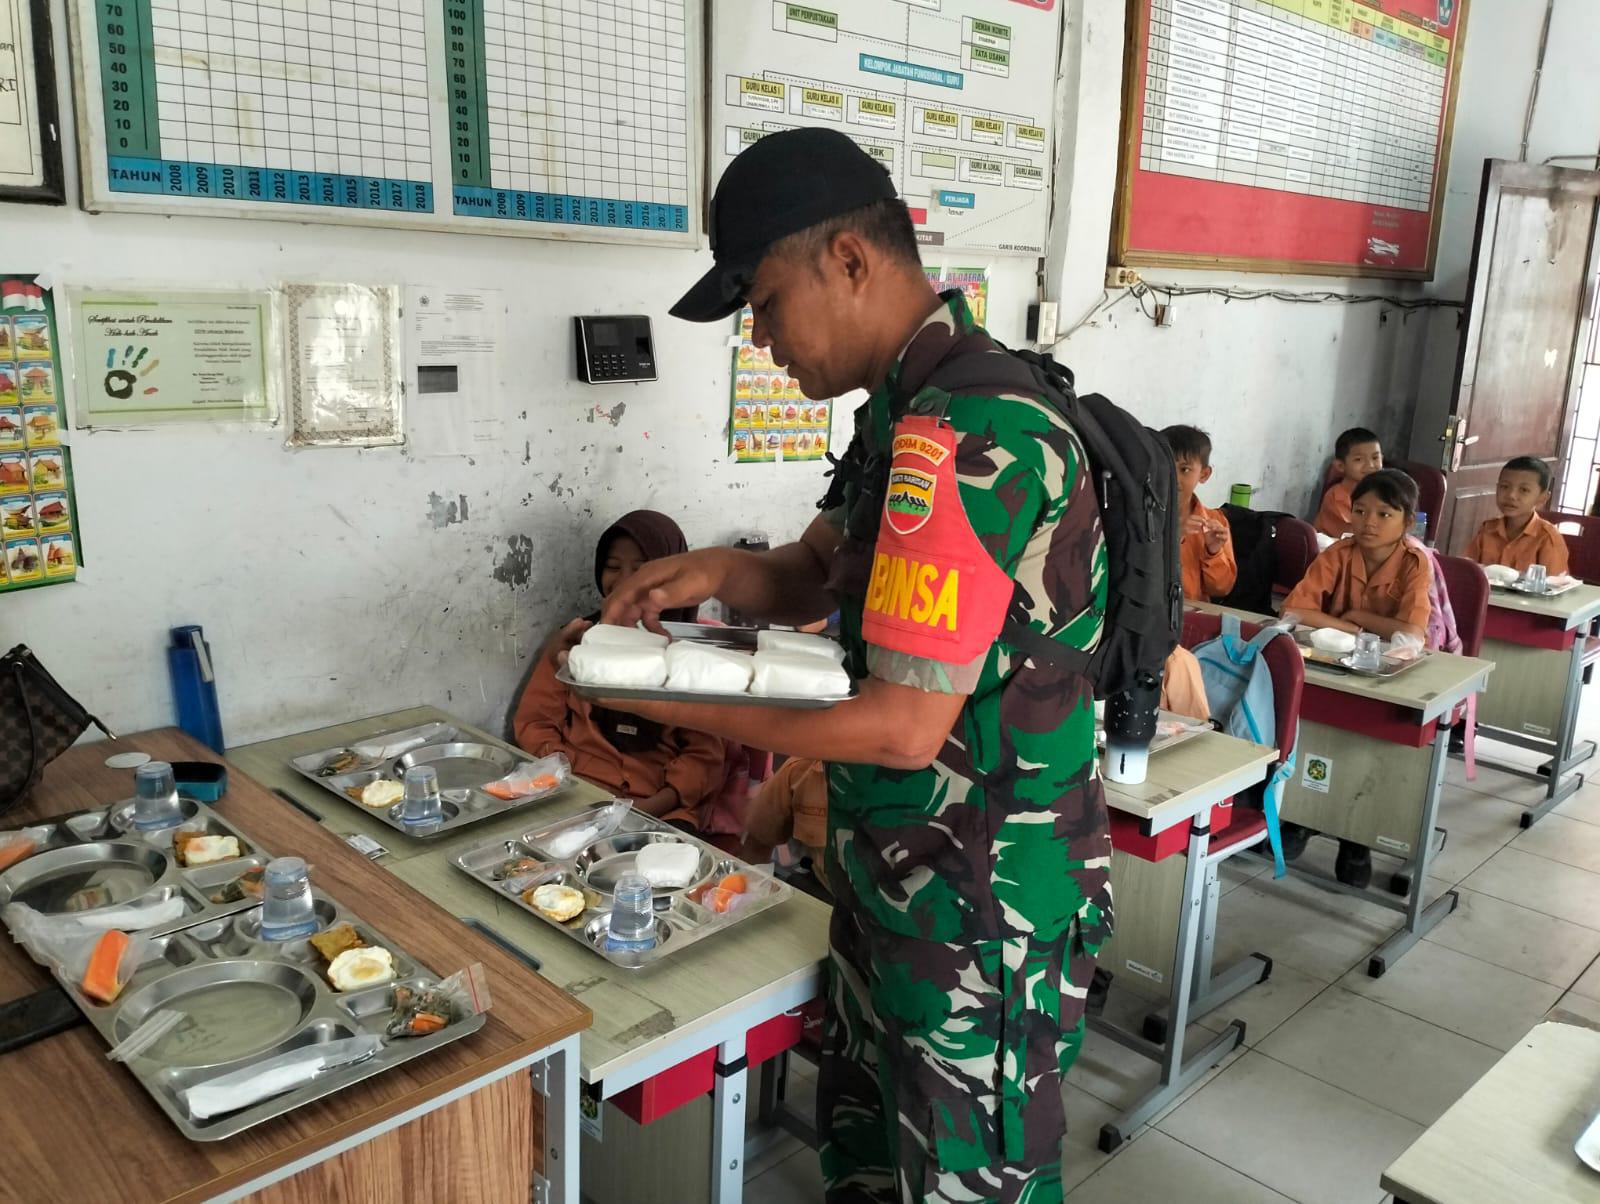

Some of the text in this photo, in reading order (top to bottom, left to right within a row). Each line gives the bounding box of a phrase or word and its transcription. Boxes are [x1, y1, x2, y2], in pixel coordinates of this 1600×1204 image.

[106, 4, 122, 16] 70
[448, 8, 466, 20] 100
[107, 24, 124, 36] 60
[451, 25, 464, 36] 90
[109, 42, 125, 55] 50
[451, 41, 464, 52] 80
[975, 49, 1006, 62] TATA USAHA
[110, 62, 127, 74] 40
[452, 57, 465, 68] 70
[453, 74, 466, 85] 60
[111, 80, 128, 93] 30
[746, 81, 760, 90] GURU
[761, 84, 777, 94] KELAS
[455, 90, 467, 100] 50
[806, 91, 820, 101] GURU
[820, 94, 835, 104] KELAS
[113, 99, 130, 112] 20
[456, 106, 468, 116] 40
[861, 100, 874, 110] GURU
[874, 103, 888, 113] KELAS
[926, 111, 937, 121] GURU
[937, 114, 951, 124] KELAS
[115, 118, 131, 130] 10
[456, 121, 469, 132] 30
[974, 119, 985, 129] GURU
[457, 137, 469, 147] 20
[743, 131, 760, 141] GURU
[119, 137, 129, 148] 0
[458, 153, 470, 163] 10
[461, 169, 468, 178] 0
[111, 164, 426, 209] TAHUN 2008 2009 2010 2011 2012 2013 2014 2015 2016 2017 2018
[454, 195, 492, 208] TAHUN
[497, 192, 507, 216] 2008
[516, 193, 526, 217] 2009
[536, 195, 545, 219] 2010
[554, 197, 563, 220] 2011
[572, 199, 581, 222] 2012
[590, 200, 599, 223] 2013
[607, 202, 616, 224] 2014
[624, 203, 633, 225] 2015
[641, 204, 650, 227] 2016
[919, 441, 944, 460] 0201
[866, 552, 960, 632] BINSA
